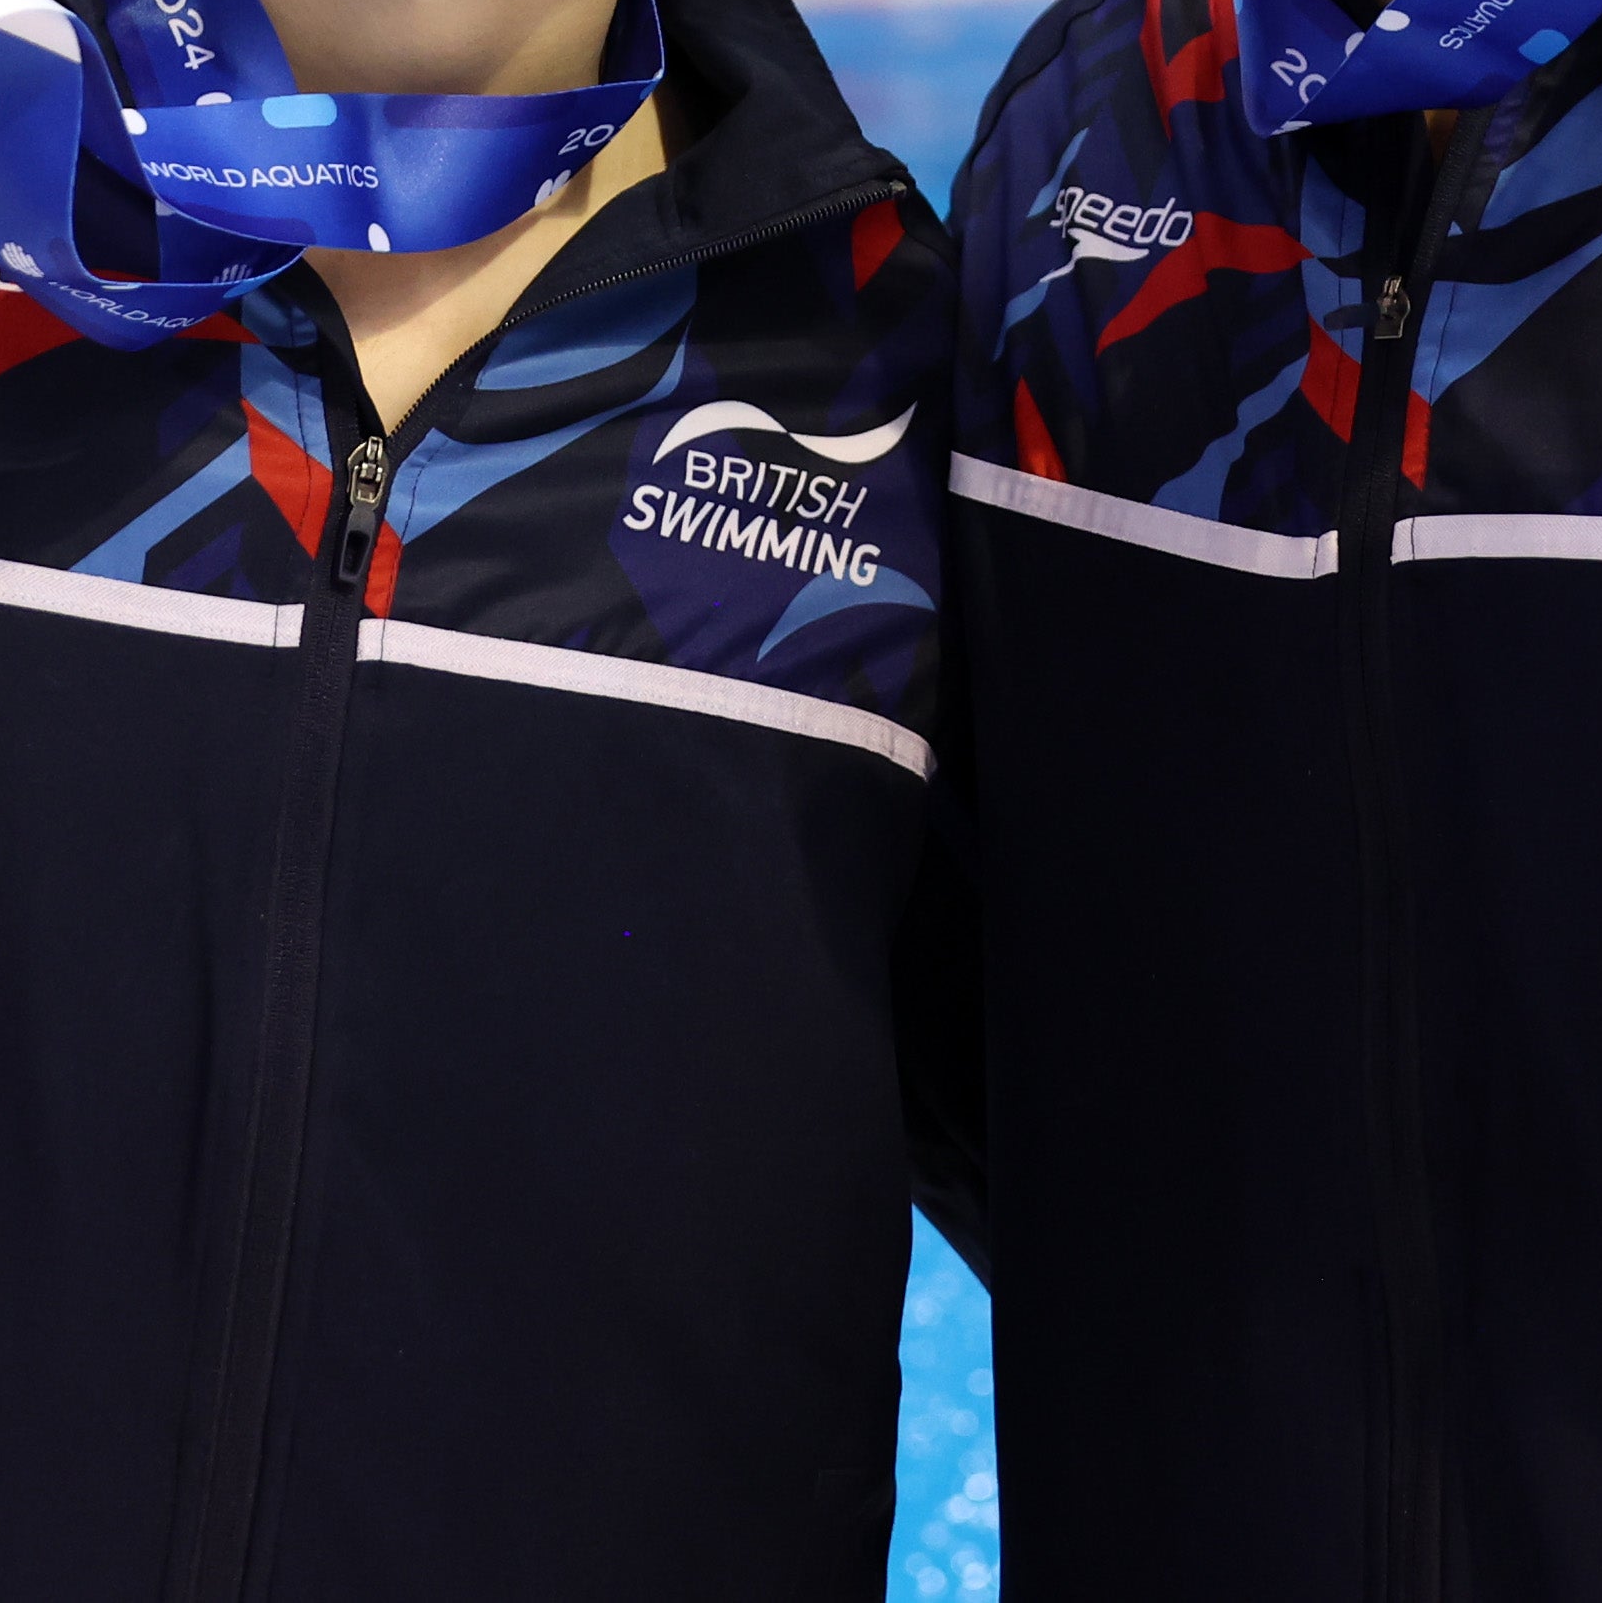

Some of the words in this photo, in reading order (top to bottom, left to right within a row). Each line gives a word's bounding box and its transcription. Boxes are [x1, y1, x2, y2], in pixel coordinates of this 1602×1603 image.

[558, 123, 626, 155] 20
[142, 161, 247, 188] WORLD
[251, 164, 379, 188] AQUATICS
[1049, 186, 1194, 247] speedo
[684, 449, 868, 528] BRITISH
[623, 484, 881, 587] SWIMMING
